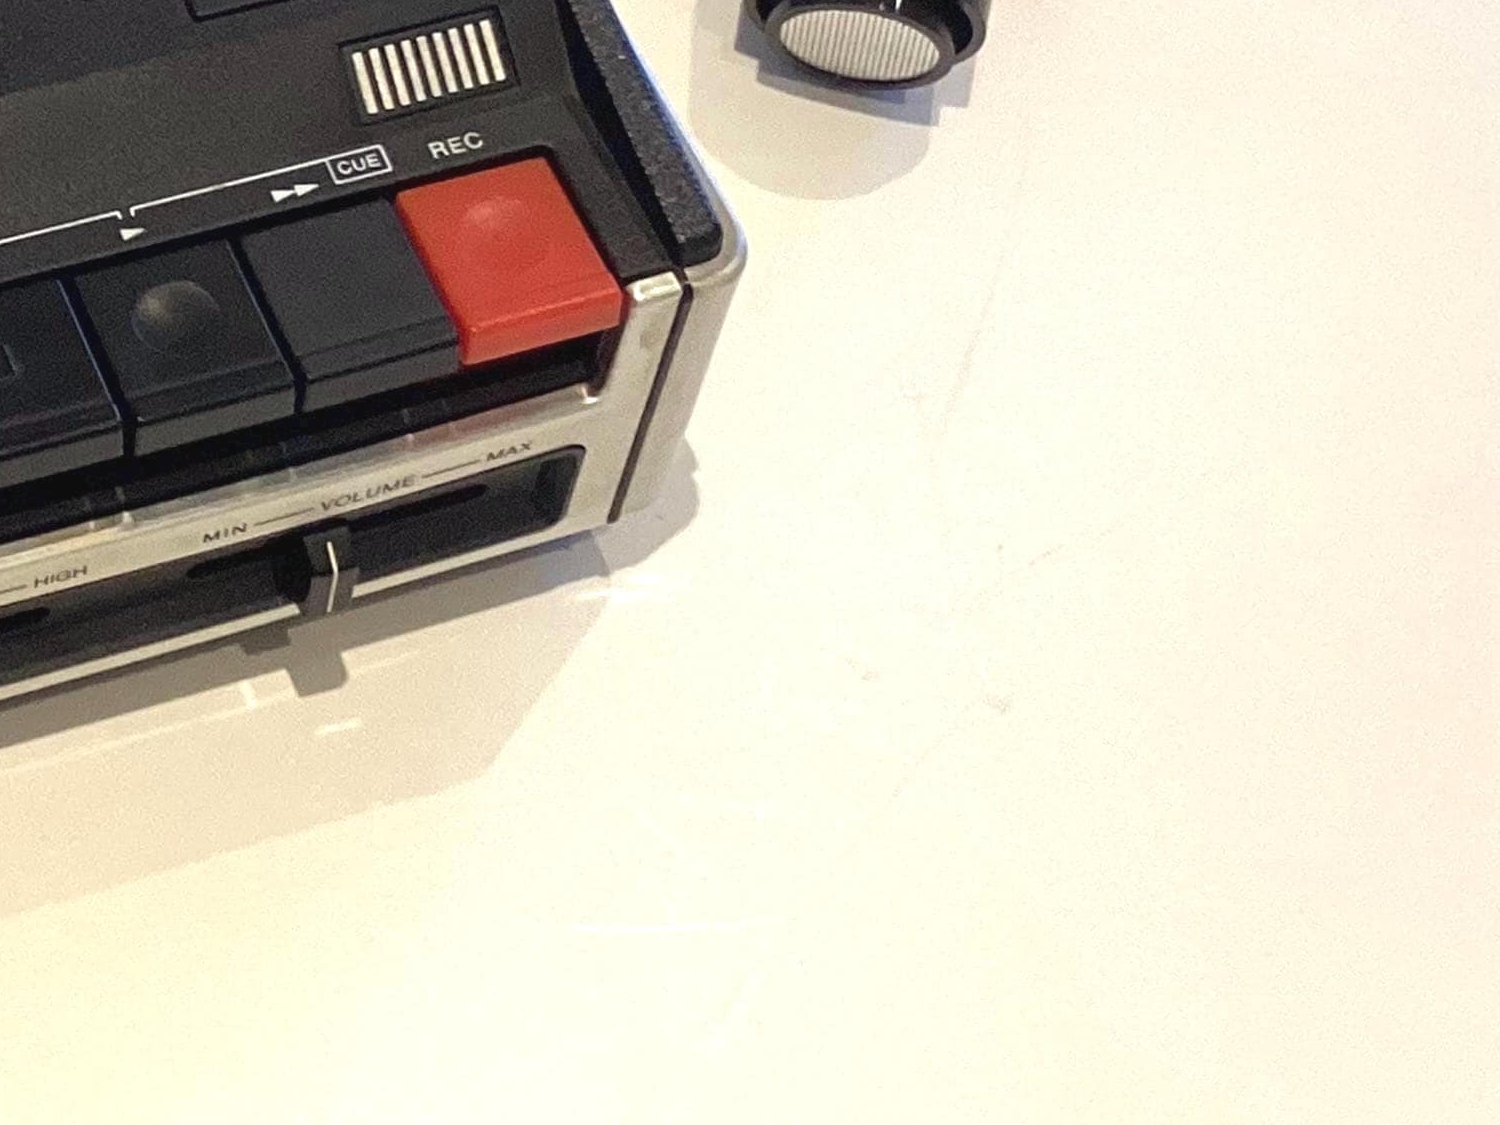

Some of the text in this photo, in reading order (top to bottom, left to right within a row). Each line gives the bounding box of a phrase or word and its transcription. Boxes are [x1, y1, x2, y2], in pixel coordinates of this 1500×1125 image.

[427, 132, 485, 159] REC
[336, 152, 382, 175] CUE
[201, 441, 534, 544] MIN VOLUME MAX
[33, 564, 89, 590] HIGH
